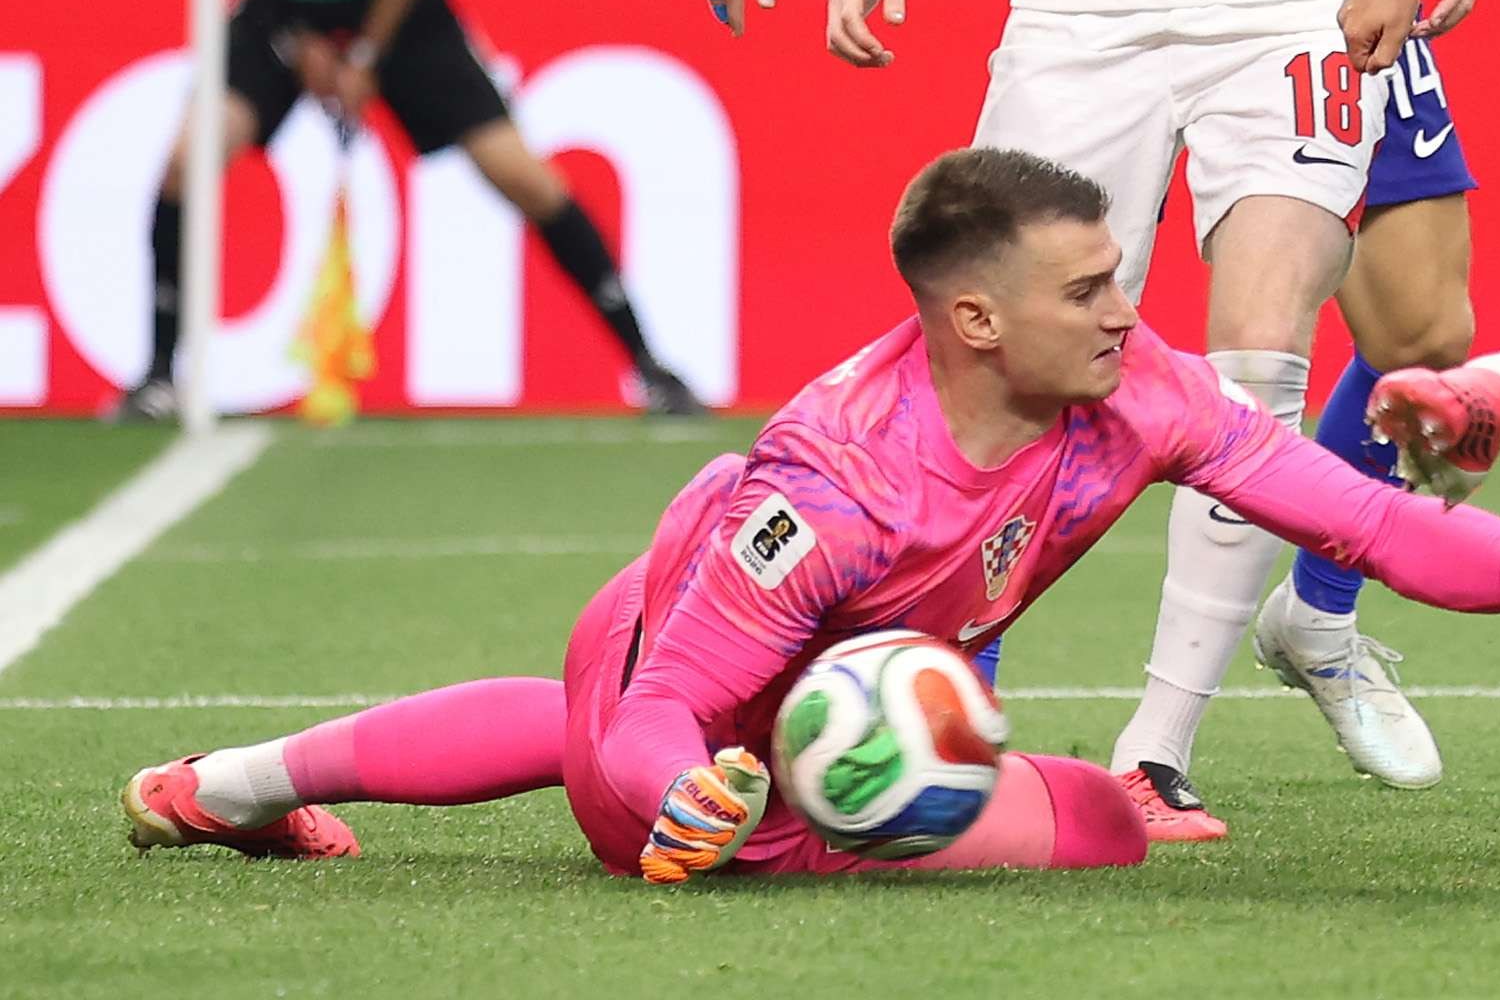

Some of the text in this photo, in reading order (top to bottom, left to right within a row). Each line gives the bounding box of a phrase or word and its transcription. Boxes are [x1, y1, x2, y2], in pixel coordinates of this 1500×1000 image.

[1284, 51, 1363, 148] 18
[1390, 38, 1448, 119] 14
[0, 45, 745, 415] on
